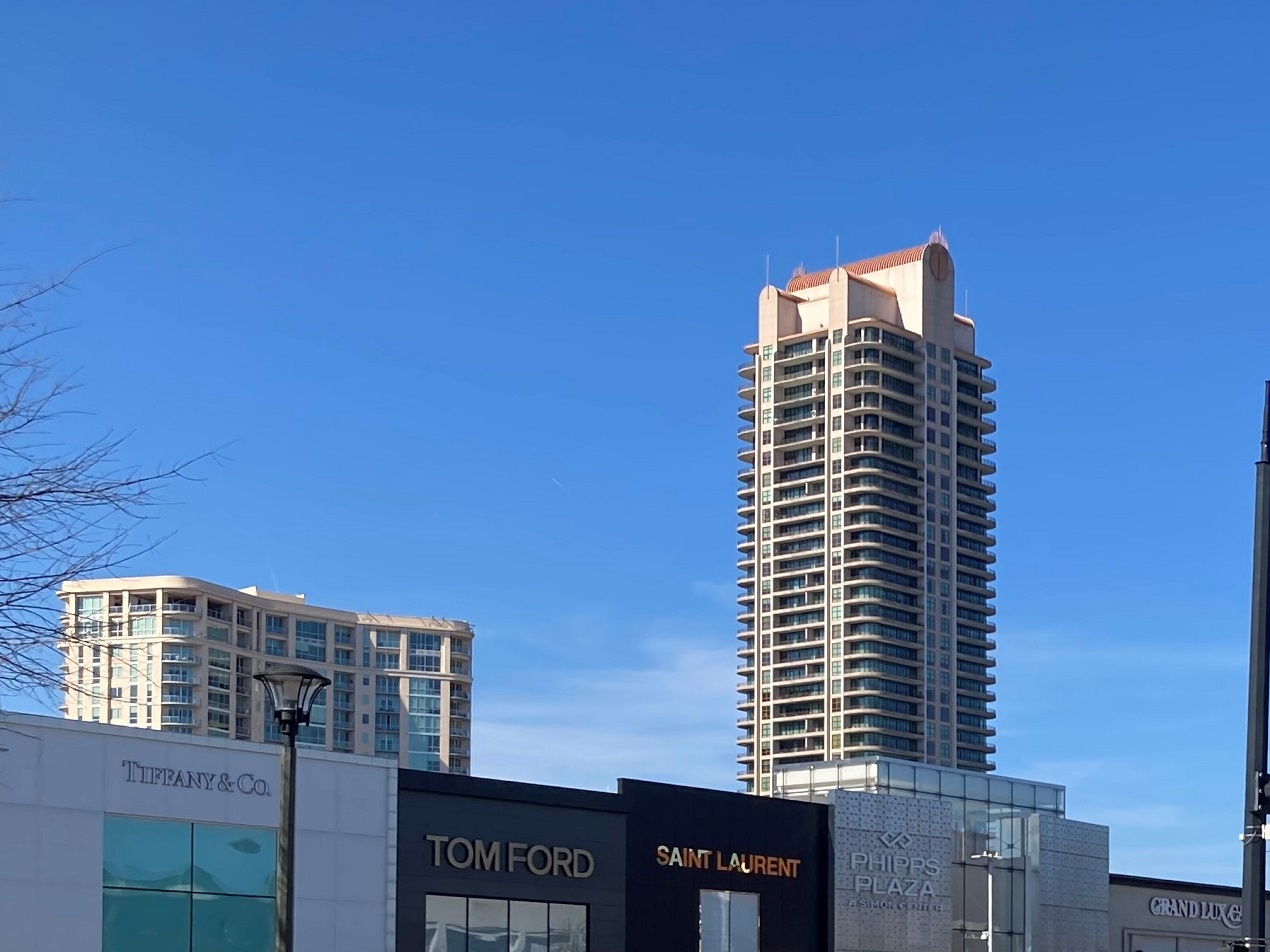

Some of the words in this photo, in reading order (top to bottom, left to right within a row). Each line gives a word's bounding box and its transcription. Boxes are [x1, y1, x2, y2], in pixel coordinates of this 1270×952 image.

[122, 760, 216, 791] TIFFANY
[424, 834, 501, 872] TOM
[507, 842, 596, 878] FORD
[656, 845, 713, 869] SAINT
[716, 851, 801, 878] LAURENT
[850, 852, 940, 877] PHIPPS
[855, 875, 936, 898] PLAZA
[1149, 897, 1199, 918] GRAND
